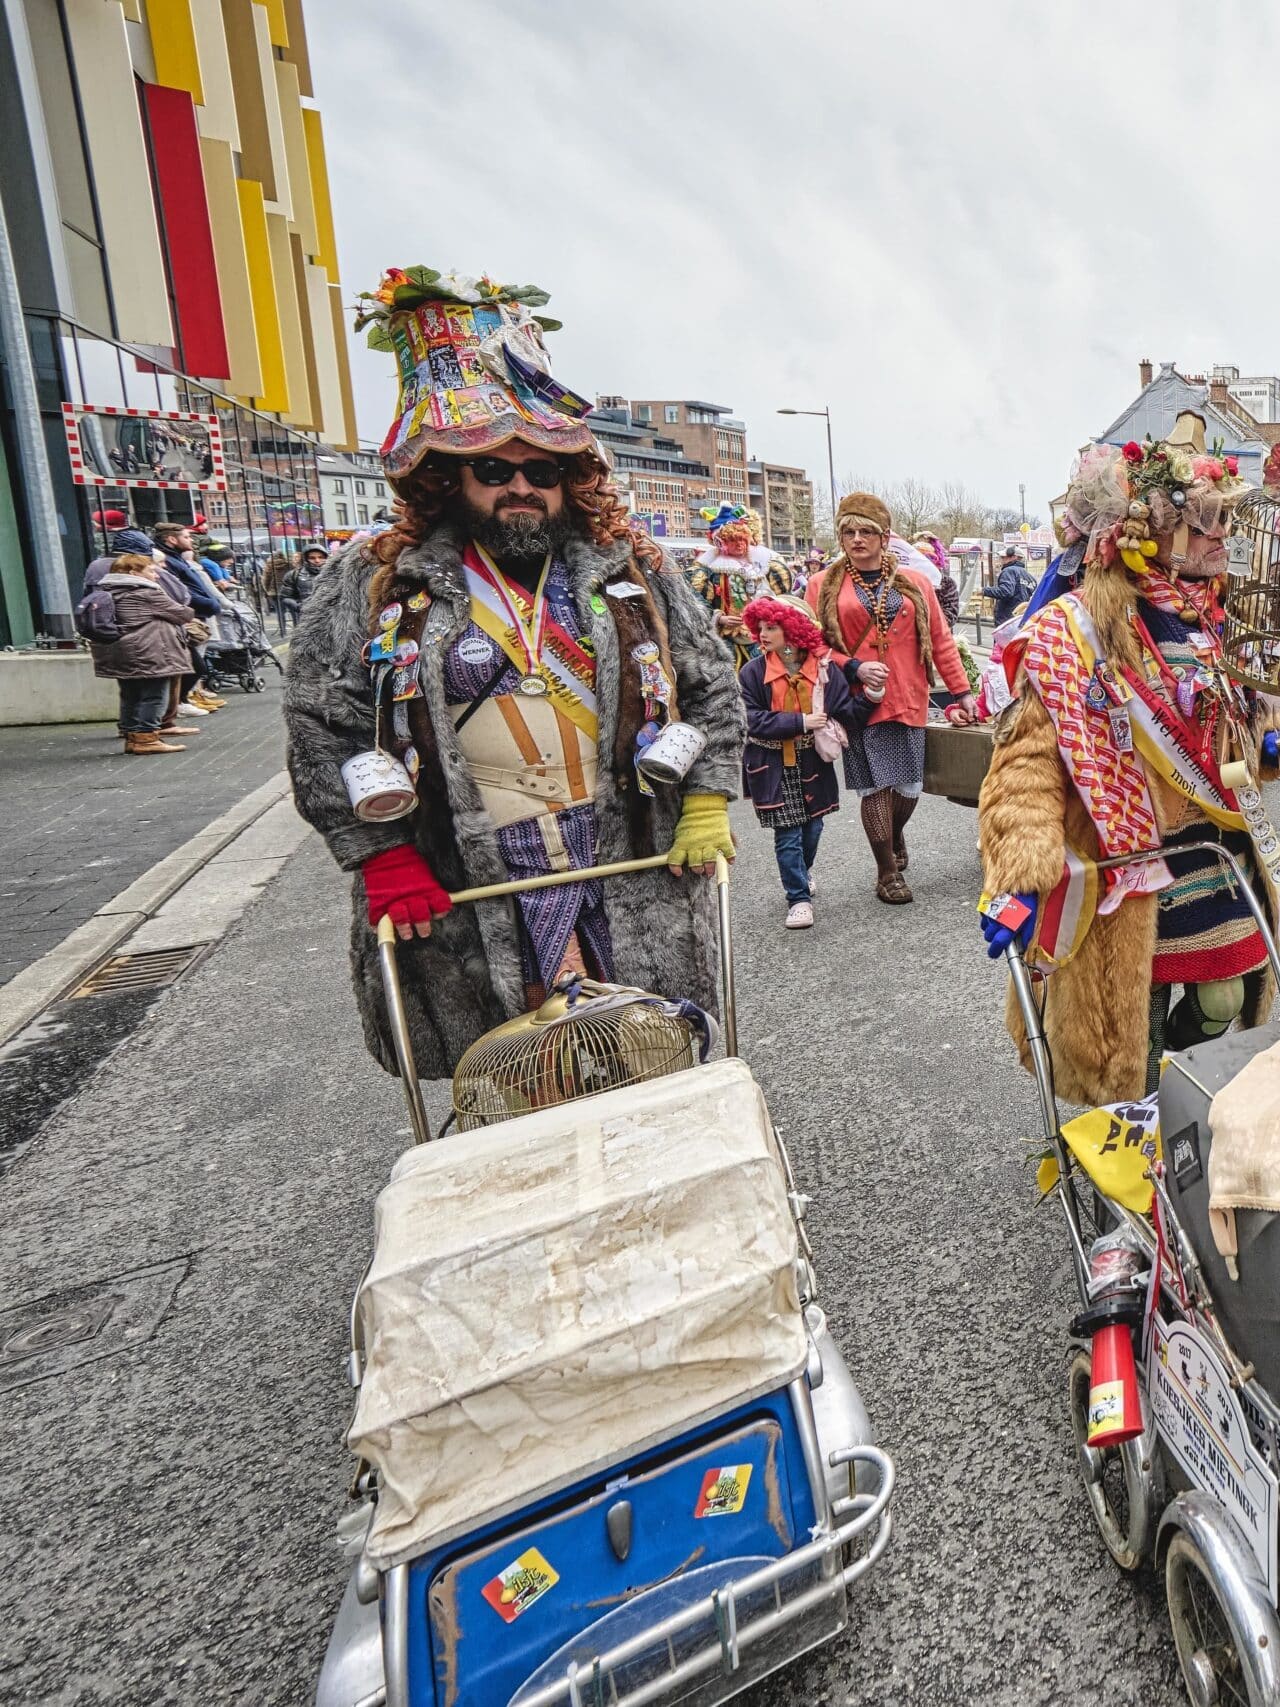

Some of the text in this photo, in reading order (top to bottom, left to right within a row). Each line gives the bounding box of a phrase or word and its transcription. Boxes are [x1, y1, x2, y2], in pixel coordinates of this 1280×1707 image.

[462, 646, 490, 656] WERNER
[1151, 707, 1175, 739] Wel
[1172, 733, 1196, 763] Voil
[1170, 767, 1196, 798] moil
[1178, 1343, 1192, 1359] 2017
[1157, 1367, 1206, 1450] KOESJKES
[1207, 1434, 1259, 1532] MIETINGK
[1184, 1445, 1199, 1463] den
